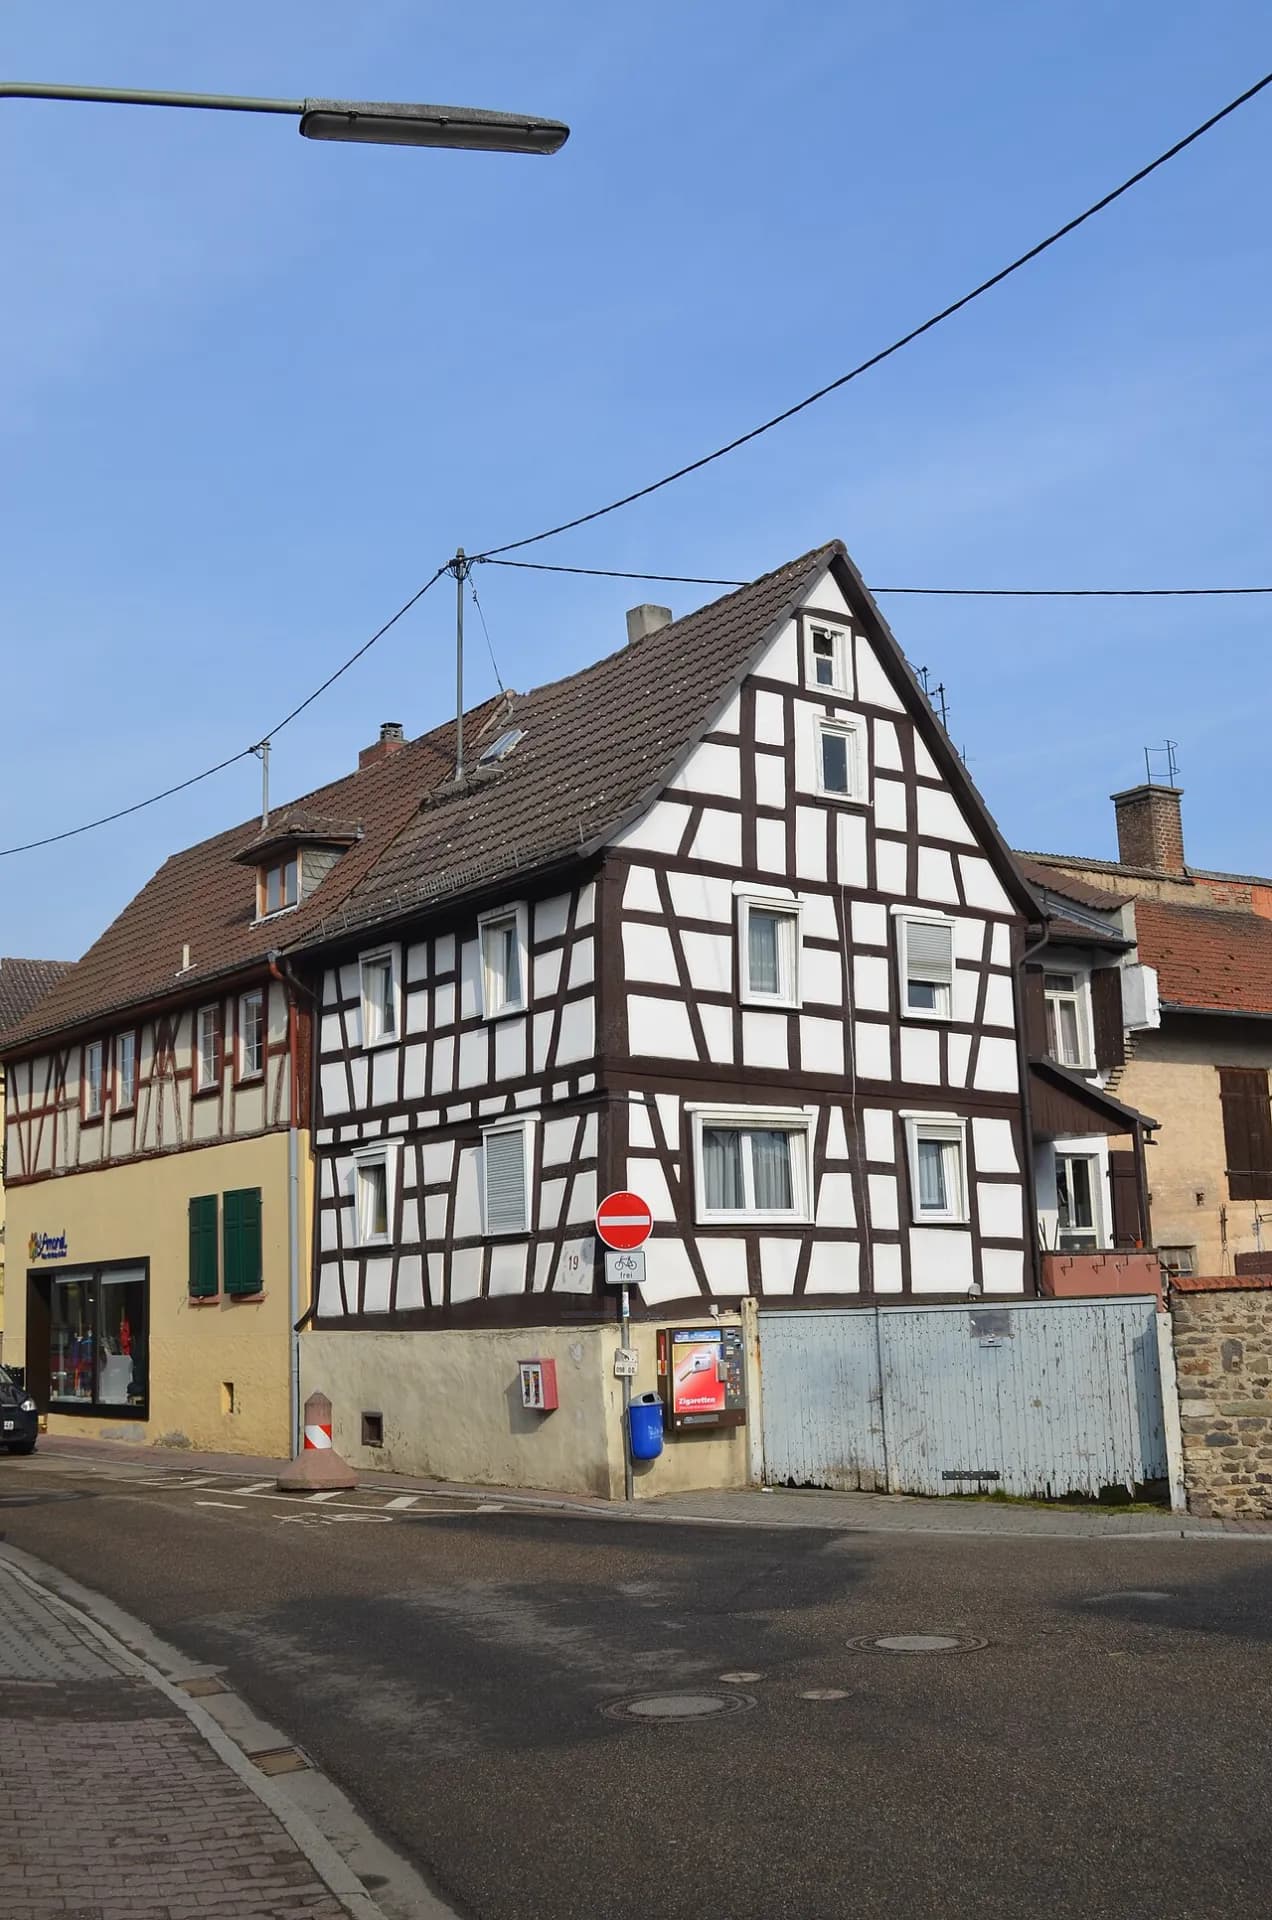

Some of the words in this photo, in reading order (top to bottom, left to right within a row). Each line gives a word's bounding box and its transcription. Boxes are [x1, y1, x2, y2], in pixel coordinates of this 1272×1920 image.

[568, 1255, 579, 1271] 19
[620, 1271, 633, 1279] frei
[678, 1396, 716, 1406] Zigaretten
